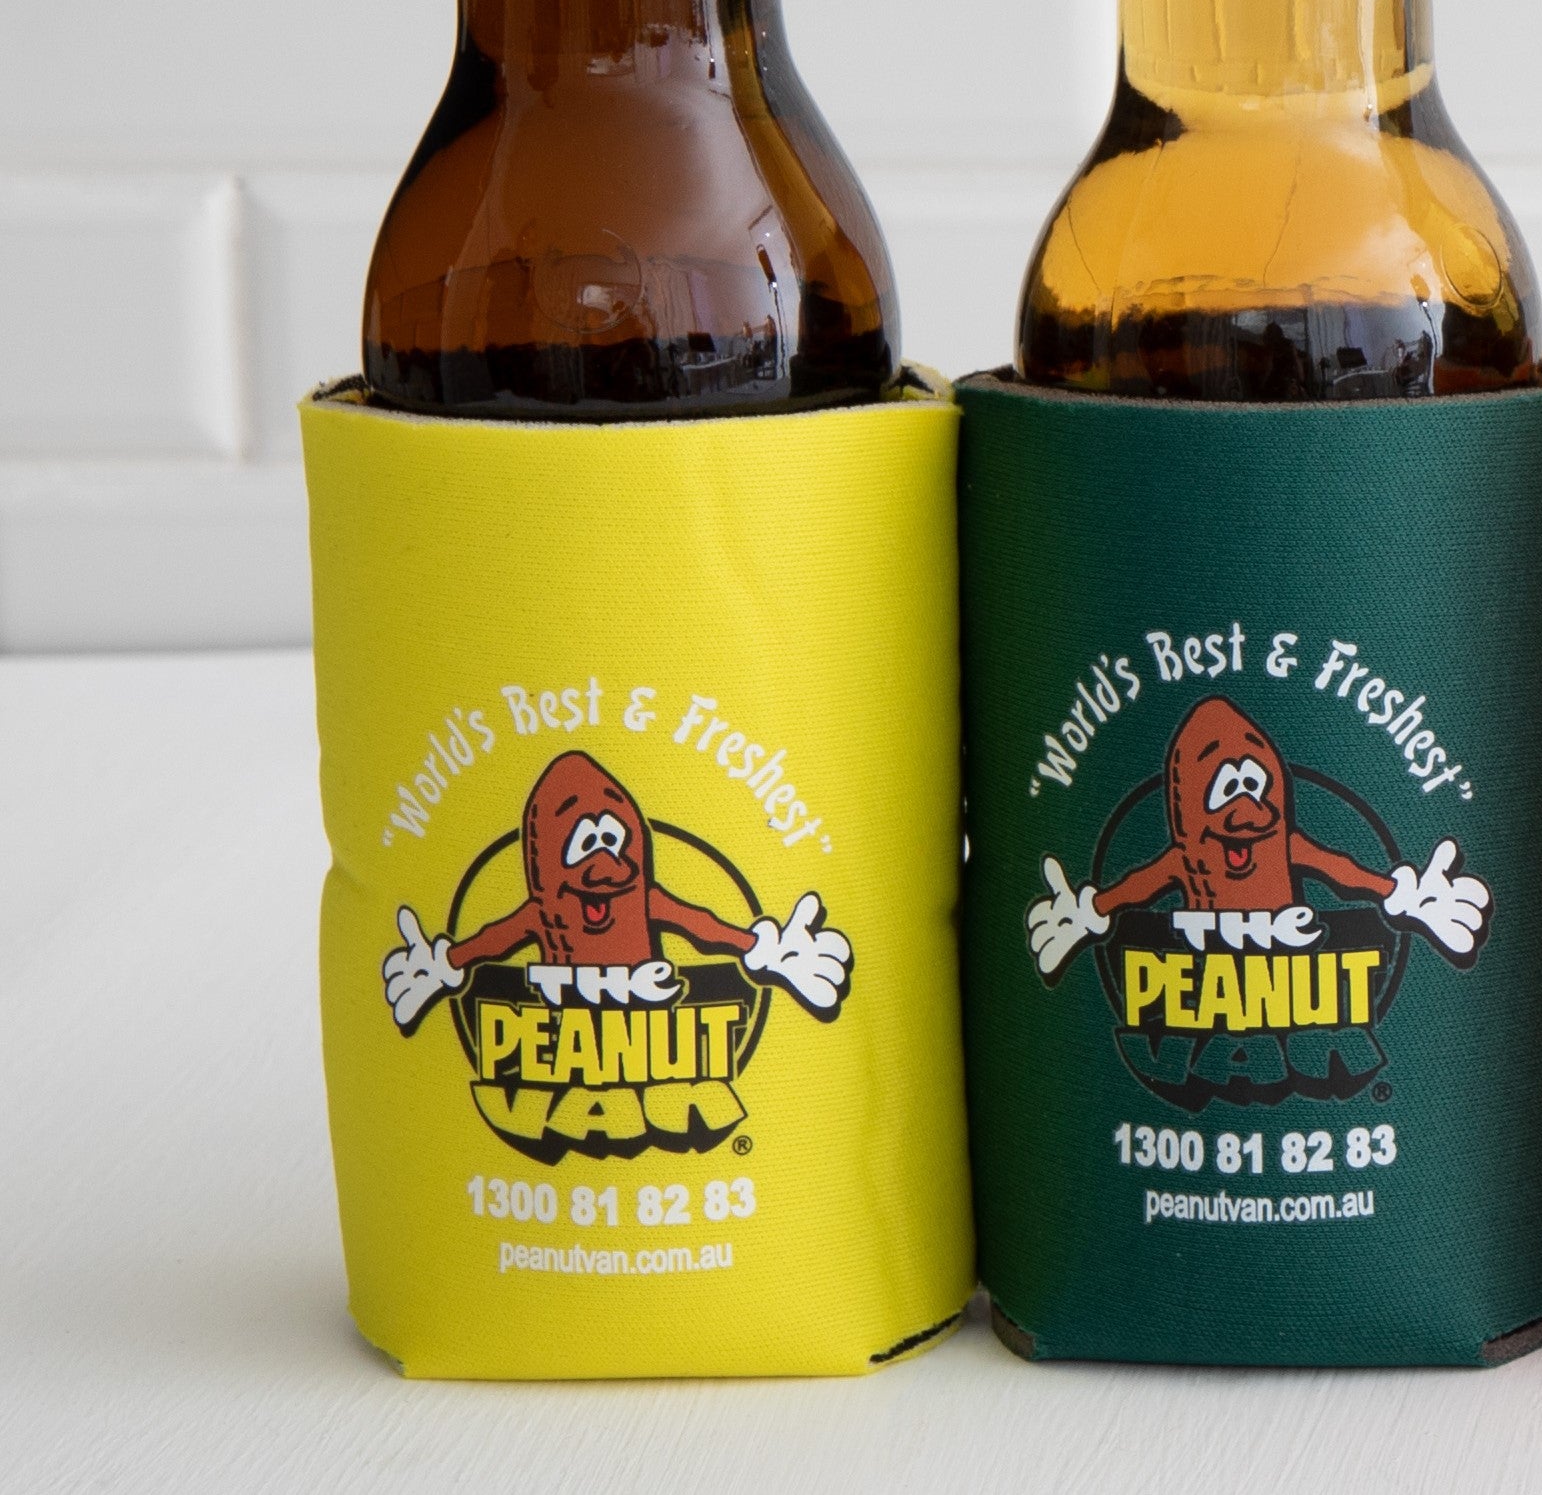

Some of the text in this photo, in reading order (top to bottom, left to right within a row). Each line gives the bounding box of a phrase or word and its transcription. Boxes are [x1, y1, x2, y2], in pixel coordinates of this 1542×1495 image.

[1146, 622, 1245, 681] Best
[1266, 633, 1298, 677] &
[500, 676, 603, 734] Best
[623, 686, 656, 732] &
[1124, 949, 1381, 1031] PEANUT
[480, 1003, 739, 1085] PEANUT
[1115, 1123, 1397, 1174] 1300 81 82 83
[466, 1174, 756, 1227] 1300 81 82 83
[1146, 1190, 1374, 1223] peanutvan.com.au
[499, 1242, 733, 1275] peanutvan.com.au
